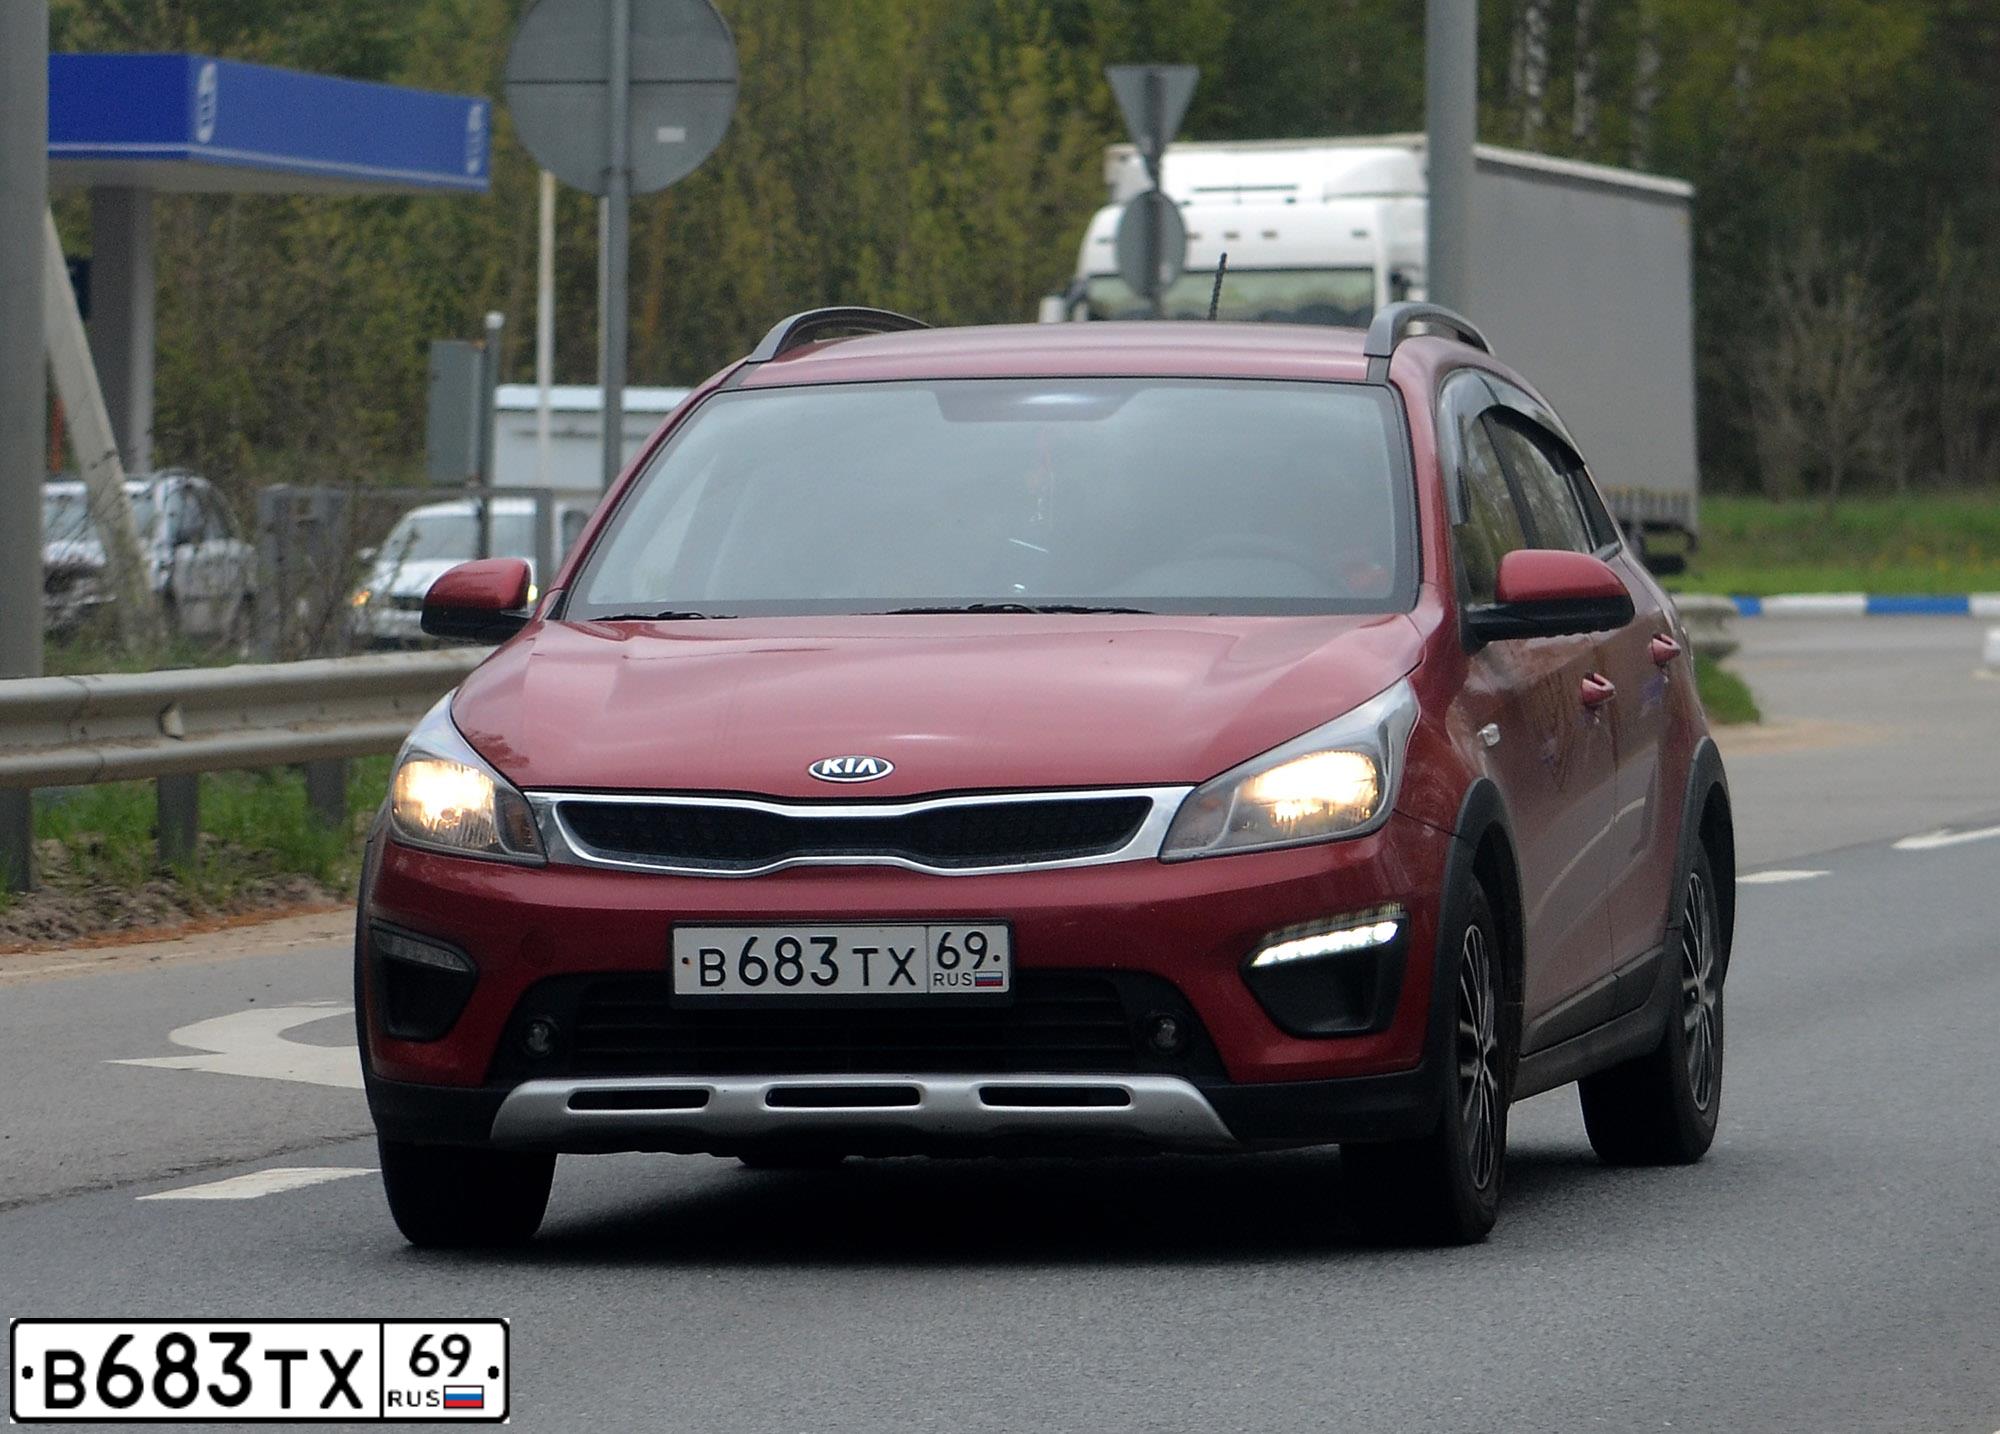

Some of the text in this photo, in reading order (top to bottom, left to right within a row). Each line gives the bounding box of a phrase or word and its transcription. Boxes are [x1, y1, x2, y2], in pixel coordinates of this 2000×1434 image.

[821, 757, 878, 775] KIA
[936, 931, 989, 970] 69
[933, 973, 972, 986] RUS
